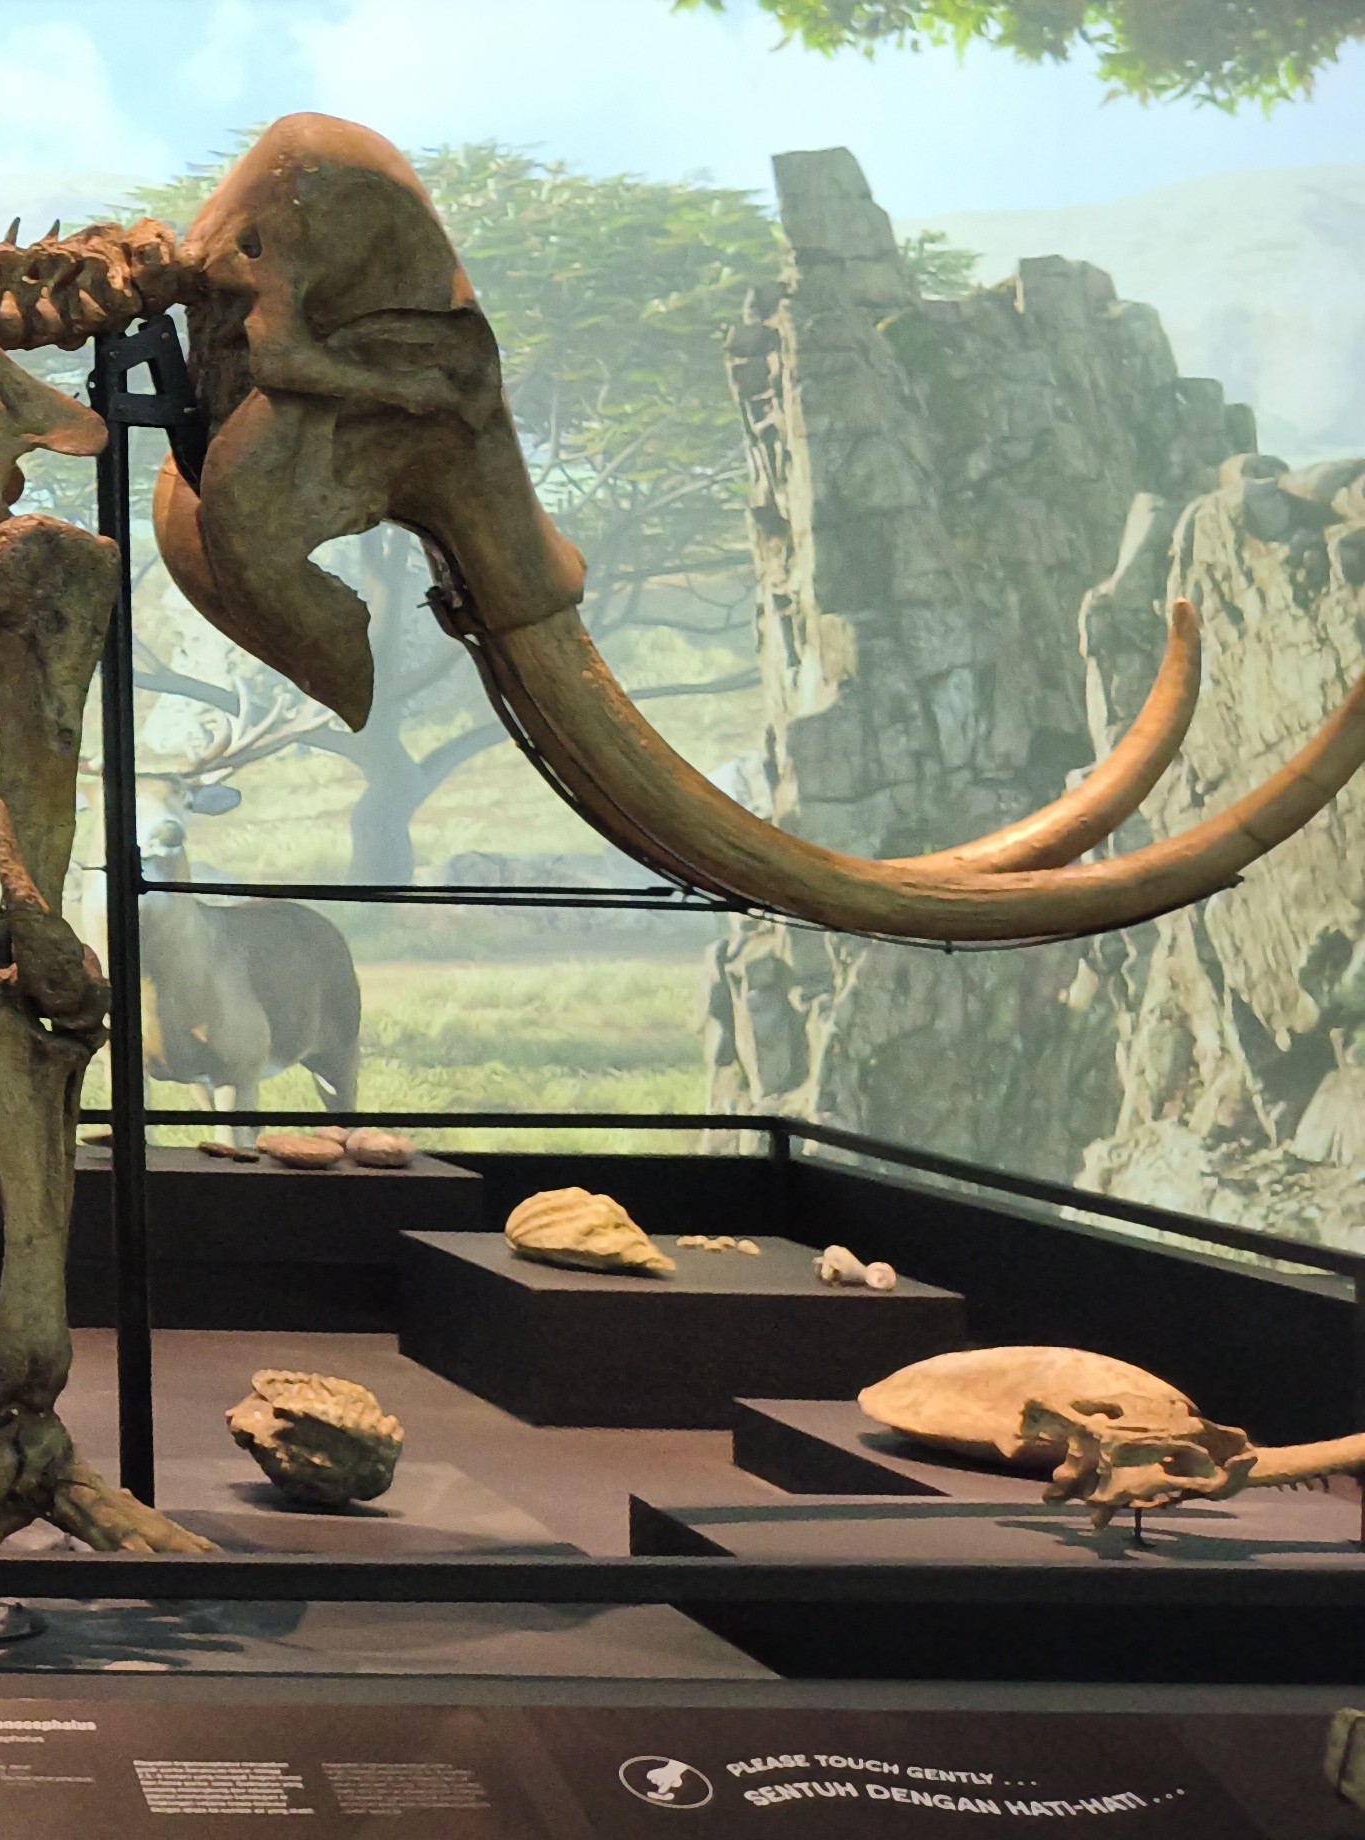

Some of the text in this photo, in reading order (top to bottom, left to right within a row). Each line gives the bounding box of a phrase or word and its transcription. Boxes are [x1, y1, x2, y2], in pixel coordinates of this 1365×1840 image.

[726, 1754, 811, 1777] PLEASE
[814, 1754, 900, 1775] TOUCH
[906, 1766, 994, 1785] GENTLY
[743, 1781, 860, 1807] SENTUH
[865, 1783, 1002, 1816] DENGAN
[1004, 1791, 1148, 1817] HATI-HATI
